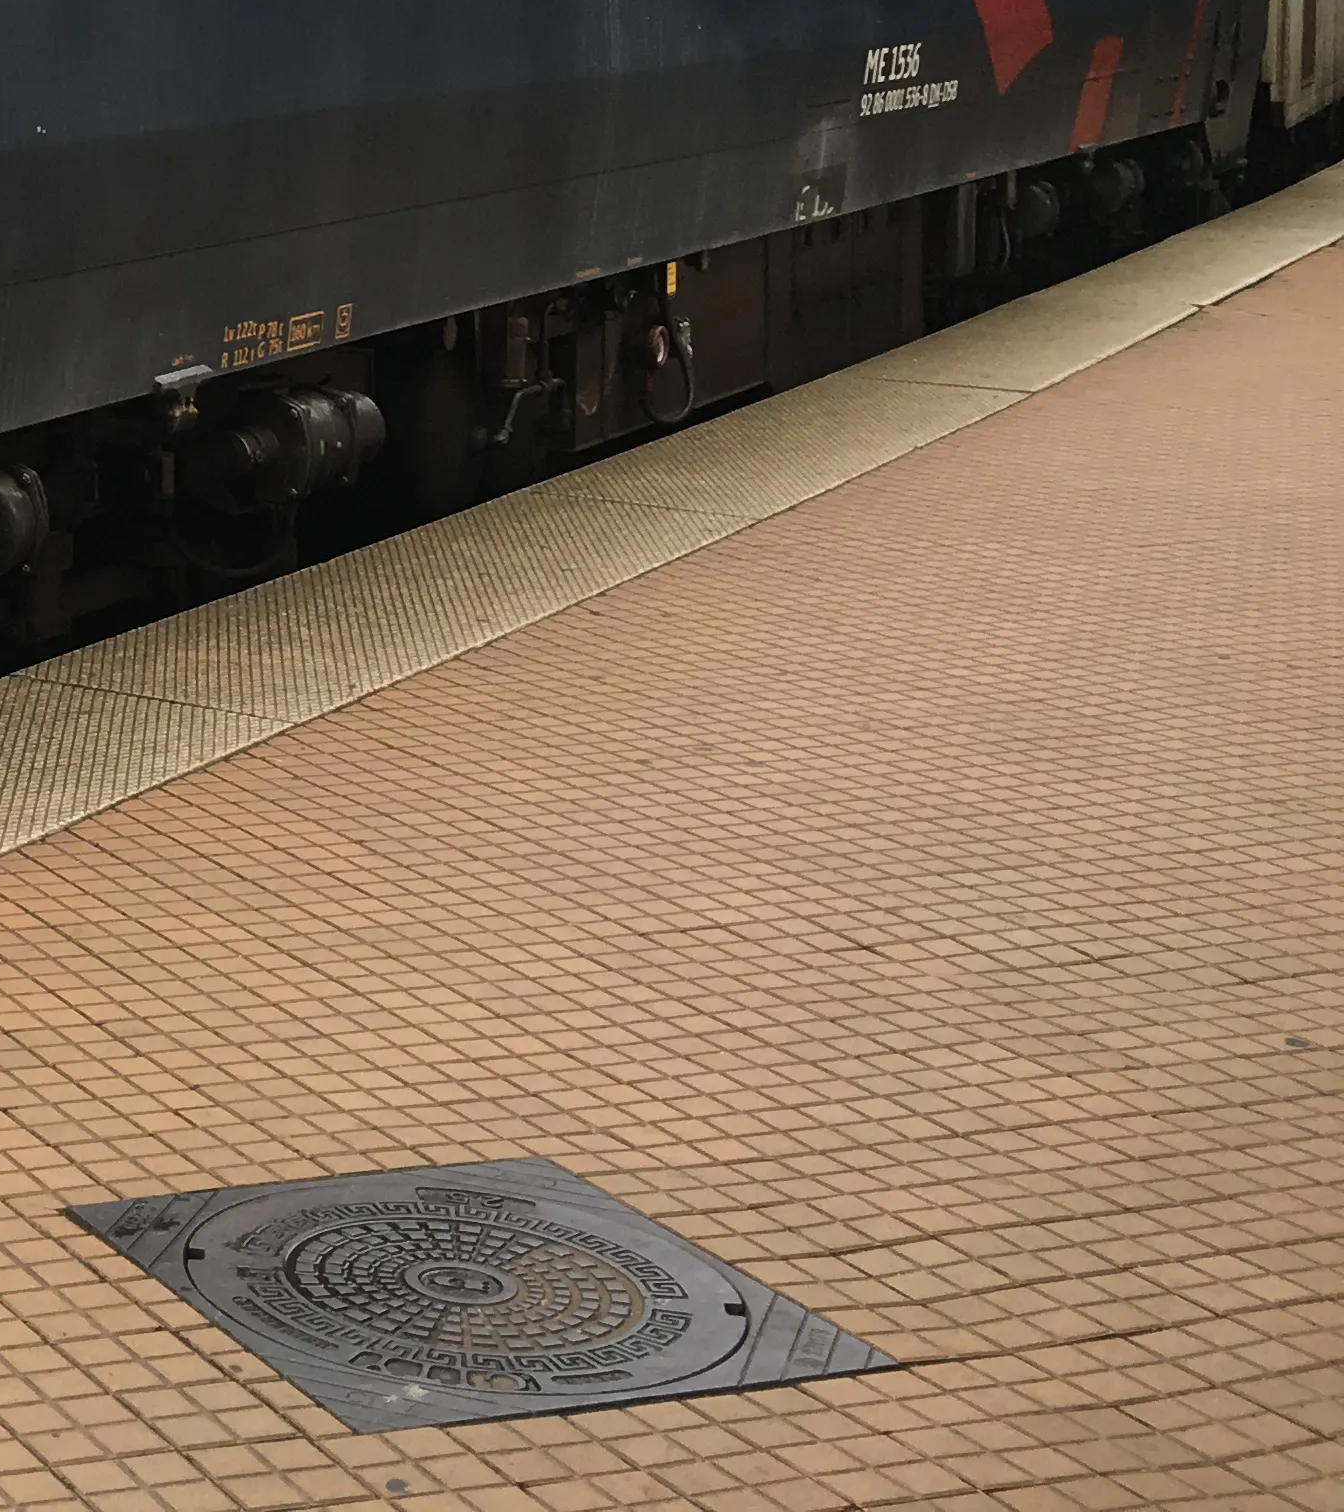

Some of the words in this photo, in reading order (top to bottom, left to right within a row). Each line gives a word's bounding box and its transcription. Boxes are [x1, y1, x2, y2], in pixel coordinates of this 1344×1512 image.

[864, 48, 889, 85] ME
[889, 42, 922, 81] 1536
[860, 93, 873, 116] 92
[872, 91, 885, 115] 86
[221, 352, 229, 368] R
